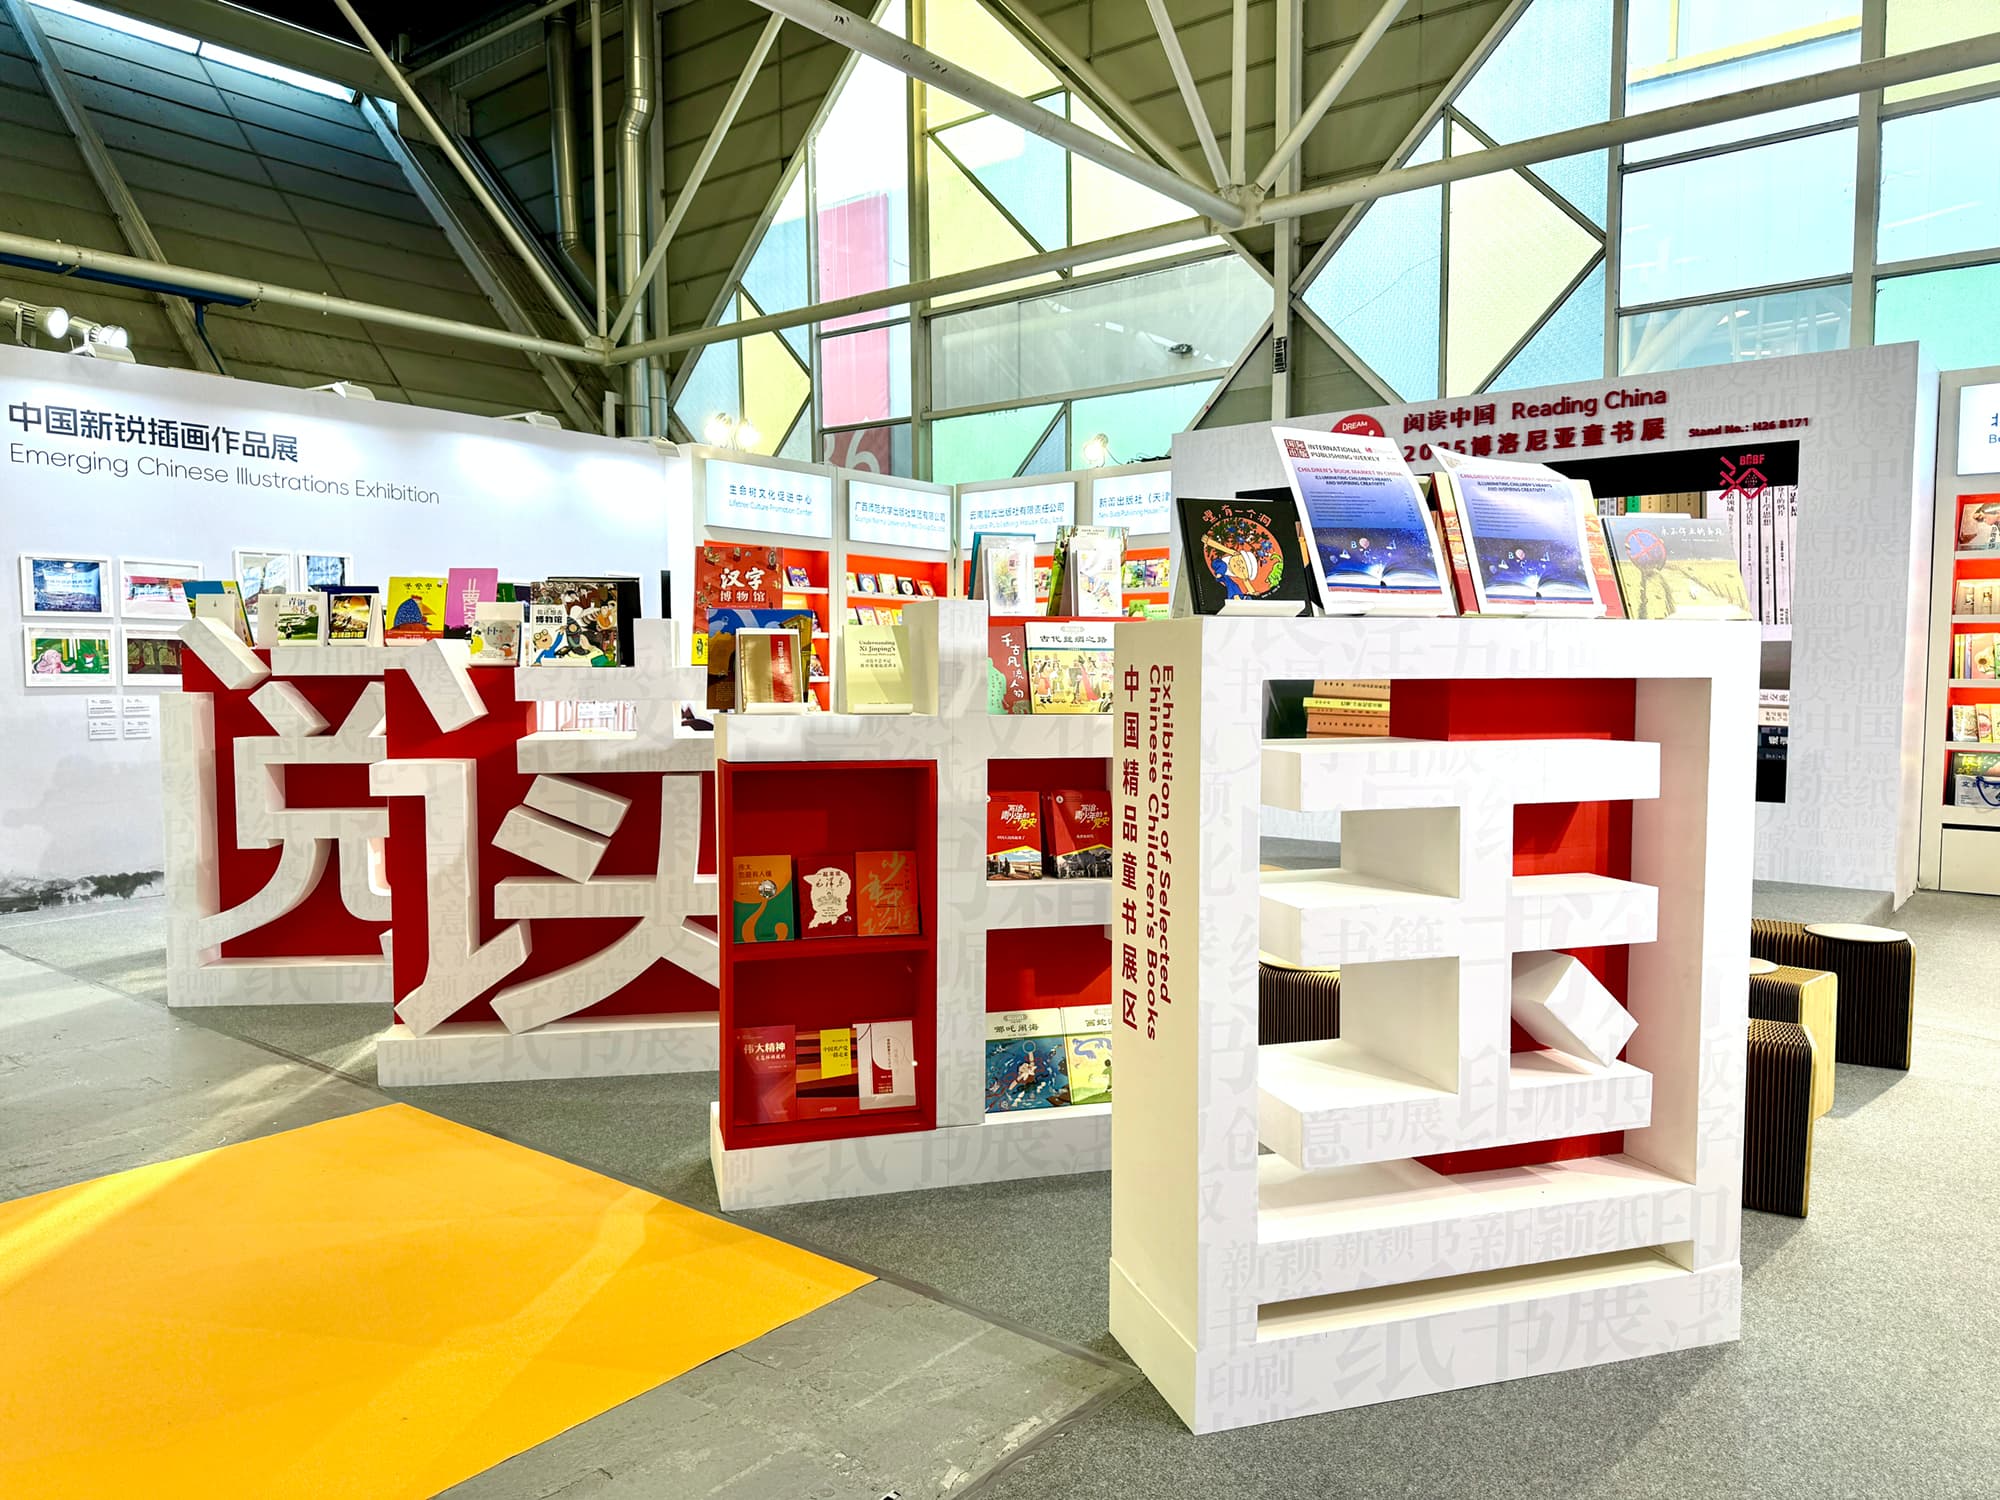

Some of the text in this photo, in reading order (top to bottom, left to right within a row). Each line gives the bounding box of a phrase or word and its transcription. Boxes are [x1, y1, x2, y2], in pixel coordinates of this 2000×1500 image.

[1403, 389, 1668, 434] 阅读中国 Reading China
[8, 401, 298, 463] 中国新锐插画作品展
[1342, 421, 1368, 432] DREAM
[1689, 425, 1722, 437] Stand
[1753, 420, 1776, 431] H26
[1779, 417, 1809, 429] B171
[1308, 443, 1362, 454] INTERNATIONAL
[1310, 452, 1353, 460] PUBLISHING
[10, 442, 440, 504] Emerging Chinese Illustrations Exhibition
[720, 568, 766, 591] 汉字
[720, 590, 766, 603] 博物馆
[535, 616, 563, 624] 博物馆
[1039, 634, 1108, 645] 古代丝绸之路
[1159, 665, 1174, 1004] Exhibition of Selected
[1121, 664, 1140, 1031] 中国精品童书展区
[1146, 664, 1161, 1041] Chinese Children's Books
[744, 1042, 786, 1055] 伟大精神
